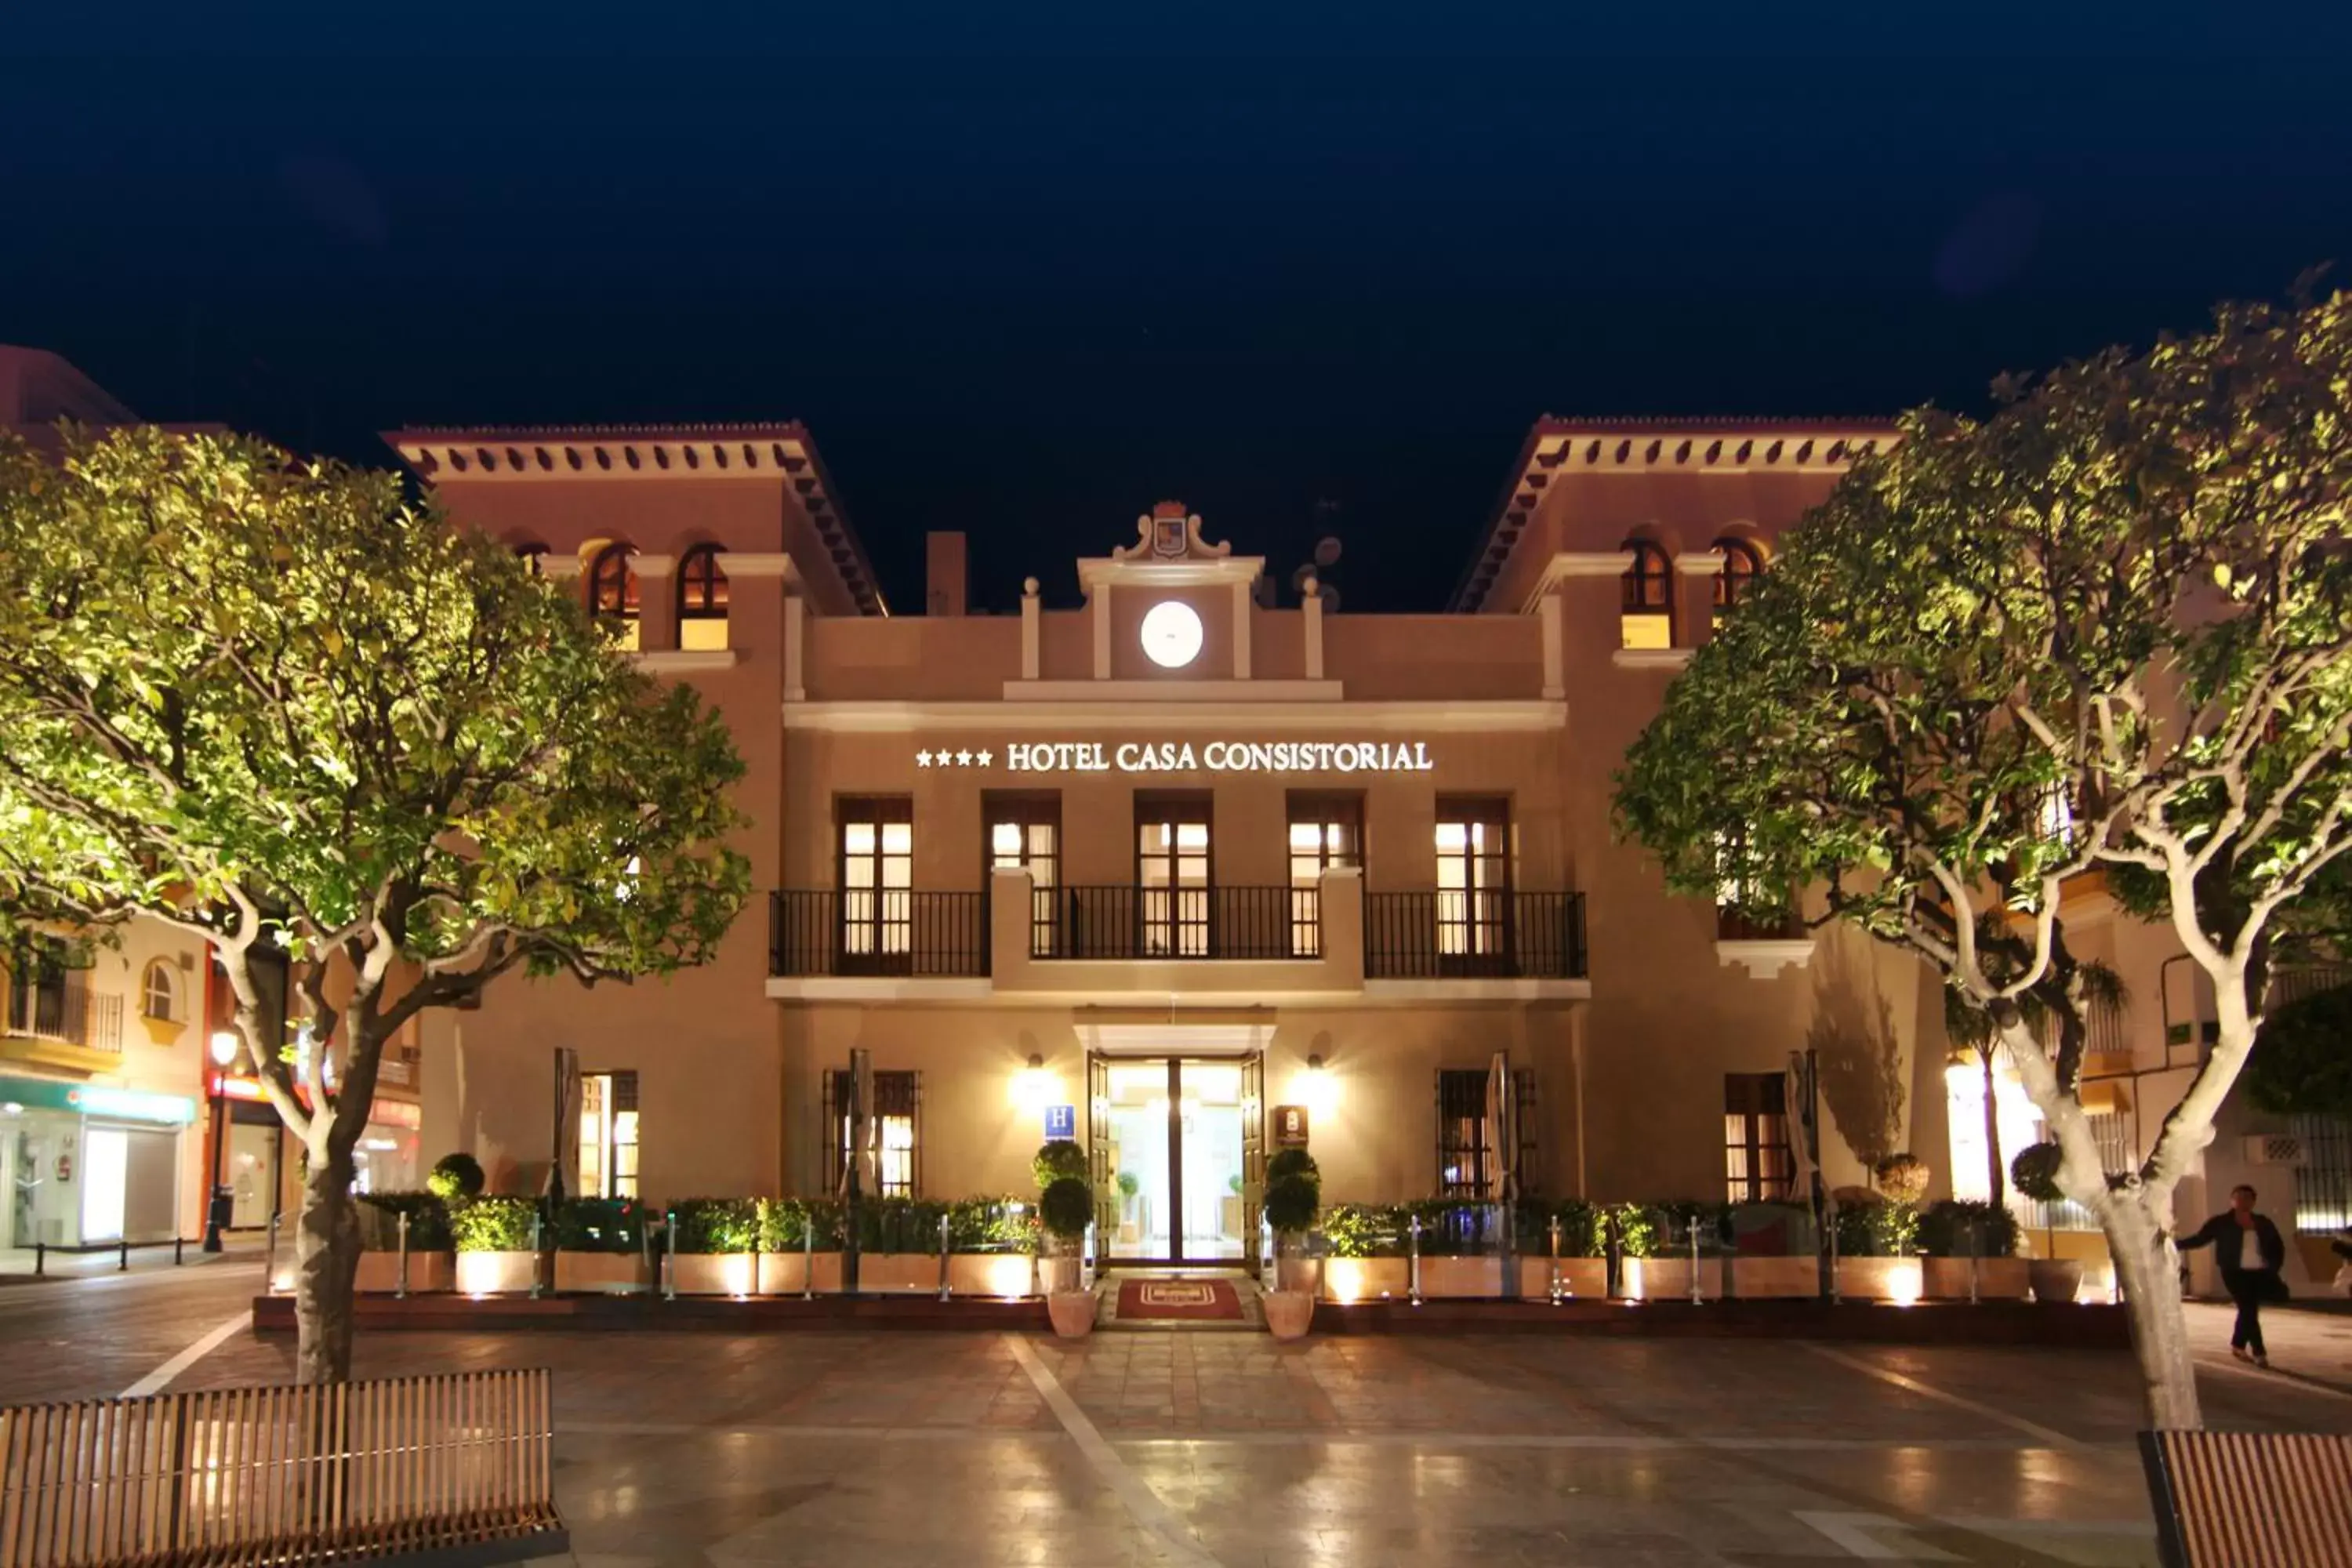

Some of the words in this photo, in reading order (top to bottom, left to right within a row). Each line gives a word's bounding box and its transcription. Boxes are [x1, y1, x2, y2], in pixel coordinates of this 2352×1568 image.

[1007, 742, 1109, 770] HOTEL
[1116, 742, 1196, 771] CASA
[1203, 742, 1433, 771] CONSISTORIAL
[1051, 1107, 1067, 1127] H
